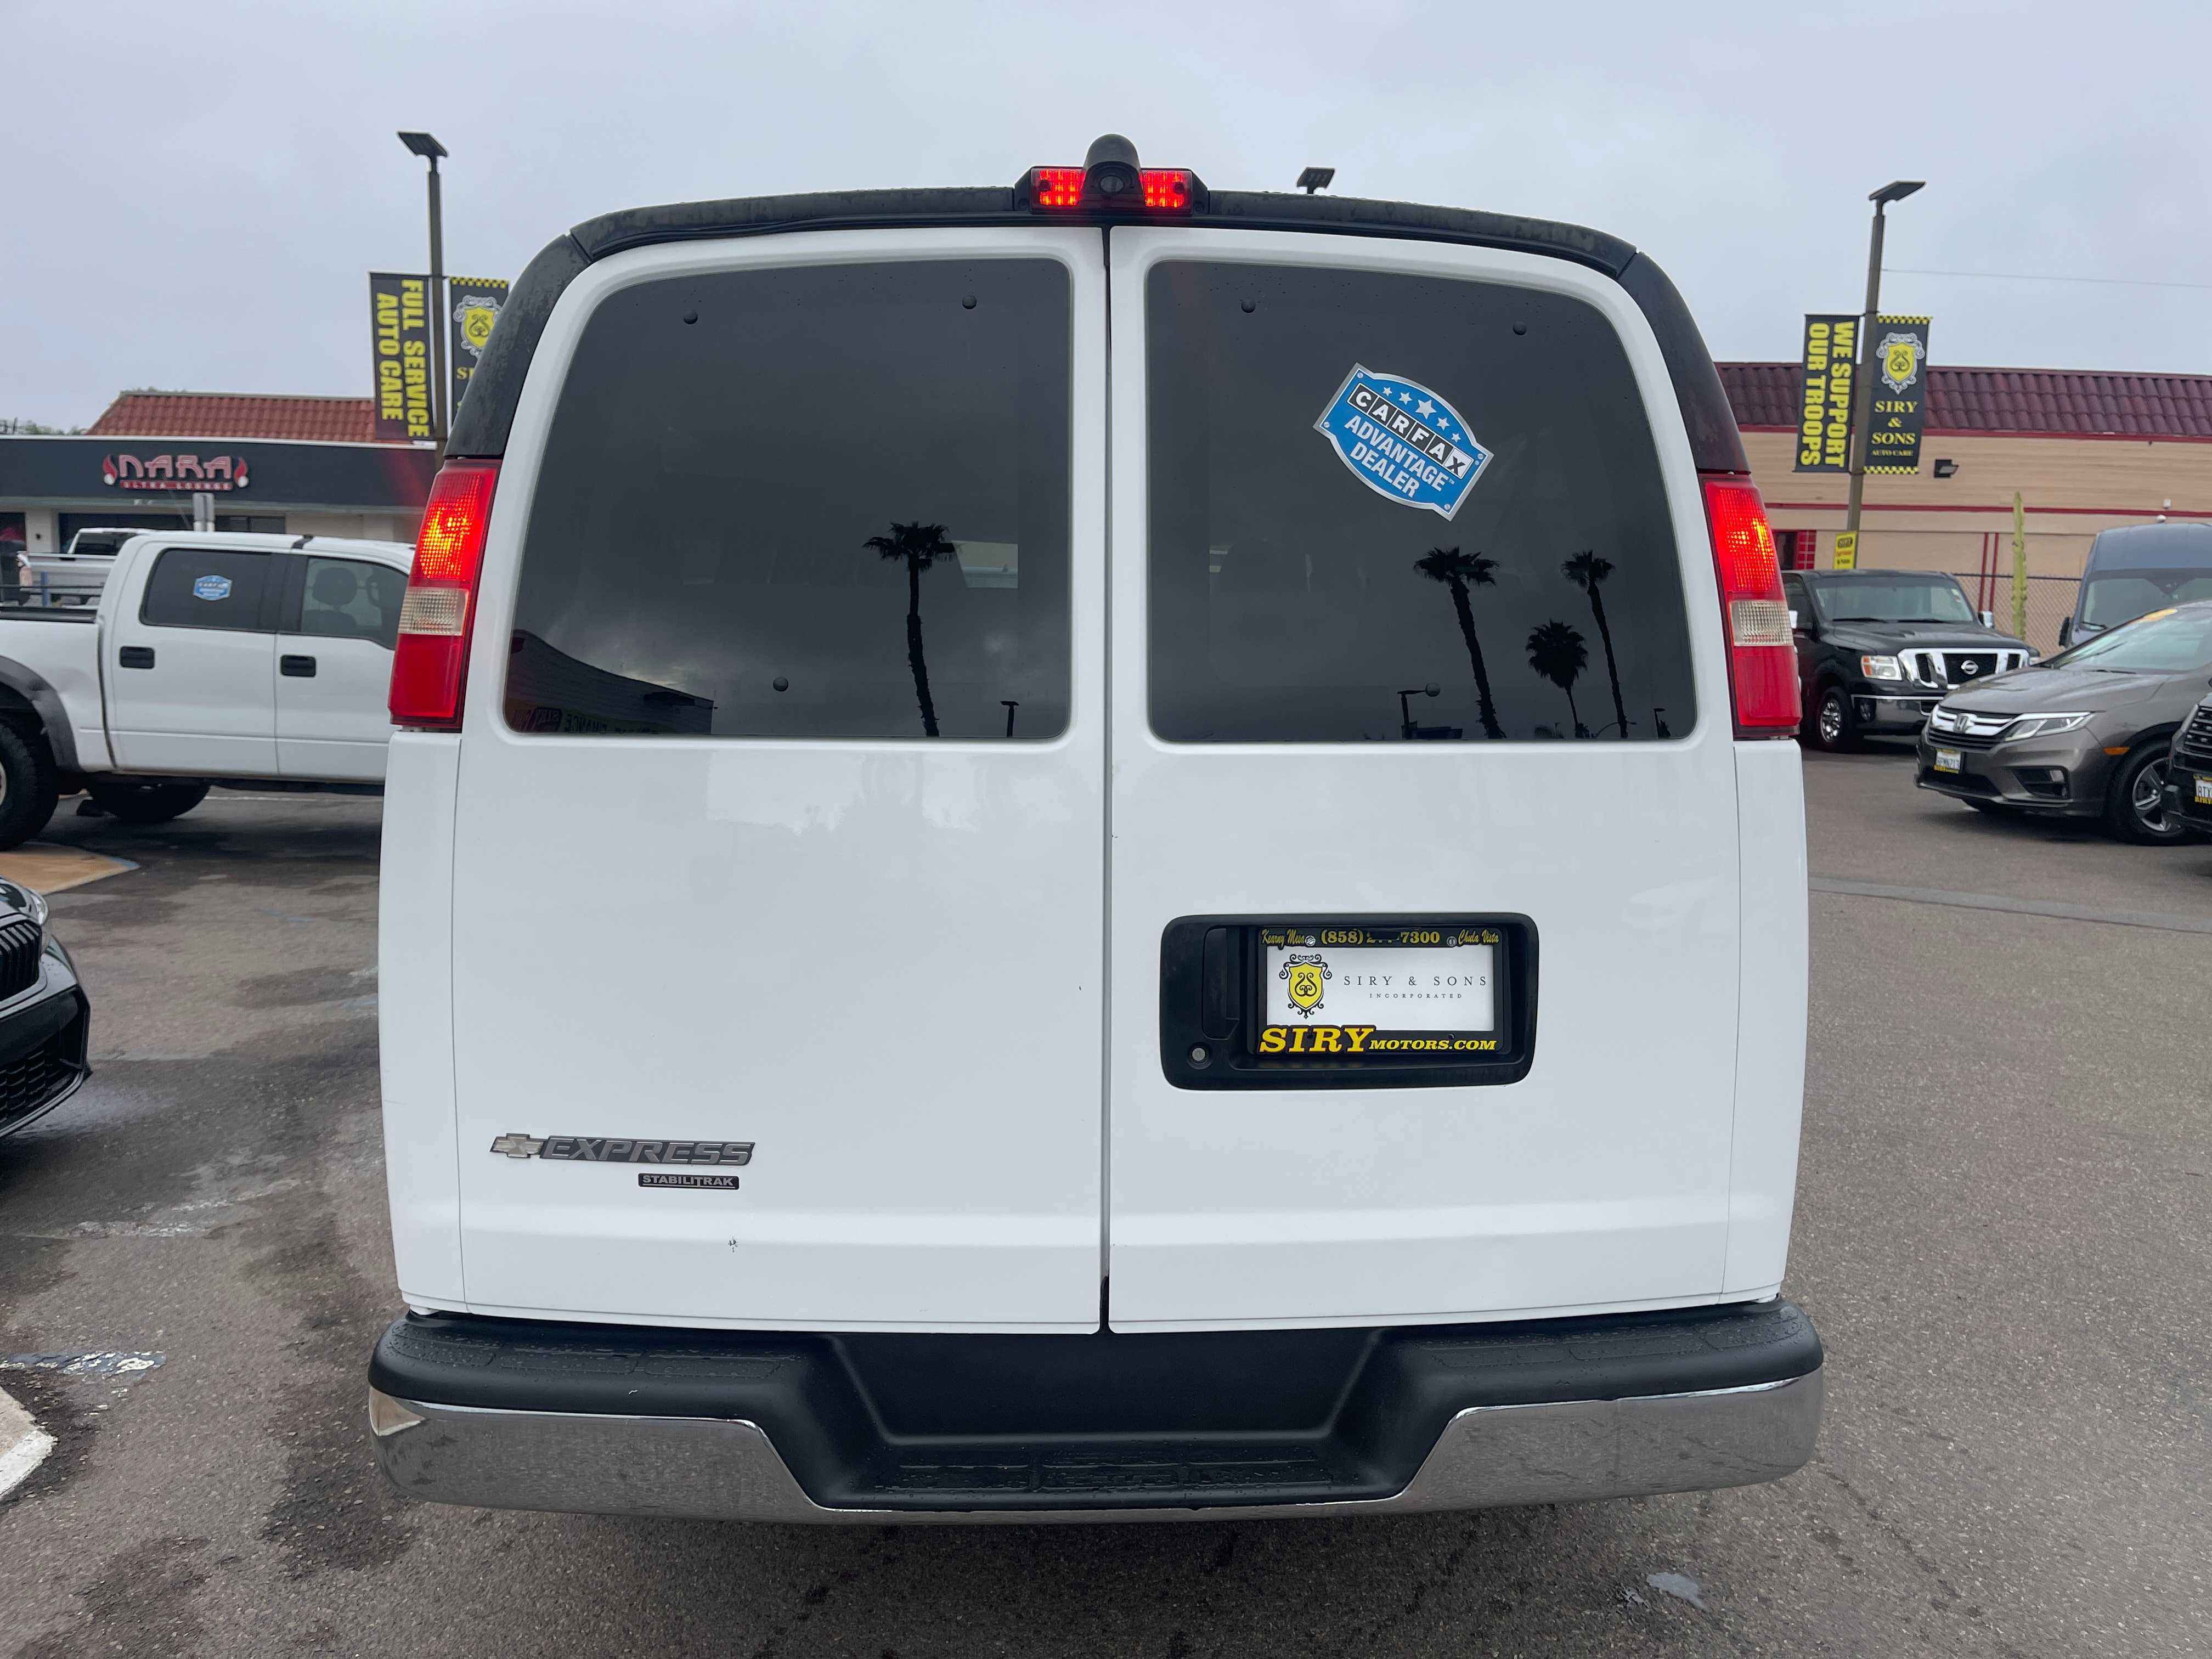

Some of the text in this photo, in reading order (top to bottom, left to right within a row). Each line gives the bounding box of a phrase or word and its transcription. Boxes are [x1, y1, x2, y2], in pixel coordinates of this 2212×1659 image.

[377, 292, 404, 421] AUTO CARE
[402, 279, 430, 437] FULL SERVICE
[1800, 323, 1830, 465] OUR TROOPS
[1825, 321, 1855, 467] WE SUPPORT
[1874, 400, 1918, 413] SIRY
[1354, 390, 1467, 476] CARFAX
[1887, 417, 1902, 427] &
[1871, 432, 1915, 445] SONS
[1345, 415, 1448, 491] ADVANTAGE
[119, 455, 232, 479] NARA
[1350, 442, 1420, 498] DEALER
[1262, 929, 1305, 948] Kearny Mesa
[1321, 929, 1364, 945] (858)
[1458, 929, 1499, 945] Chula Vista
[1344, 975, 1487, 986] SIRY & SONS
[543, 1137, 752, 1165] EXPRESS
[642, 1174, 735, 1187] STABILITRAK
